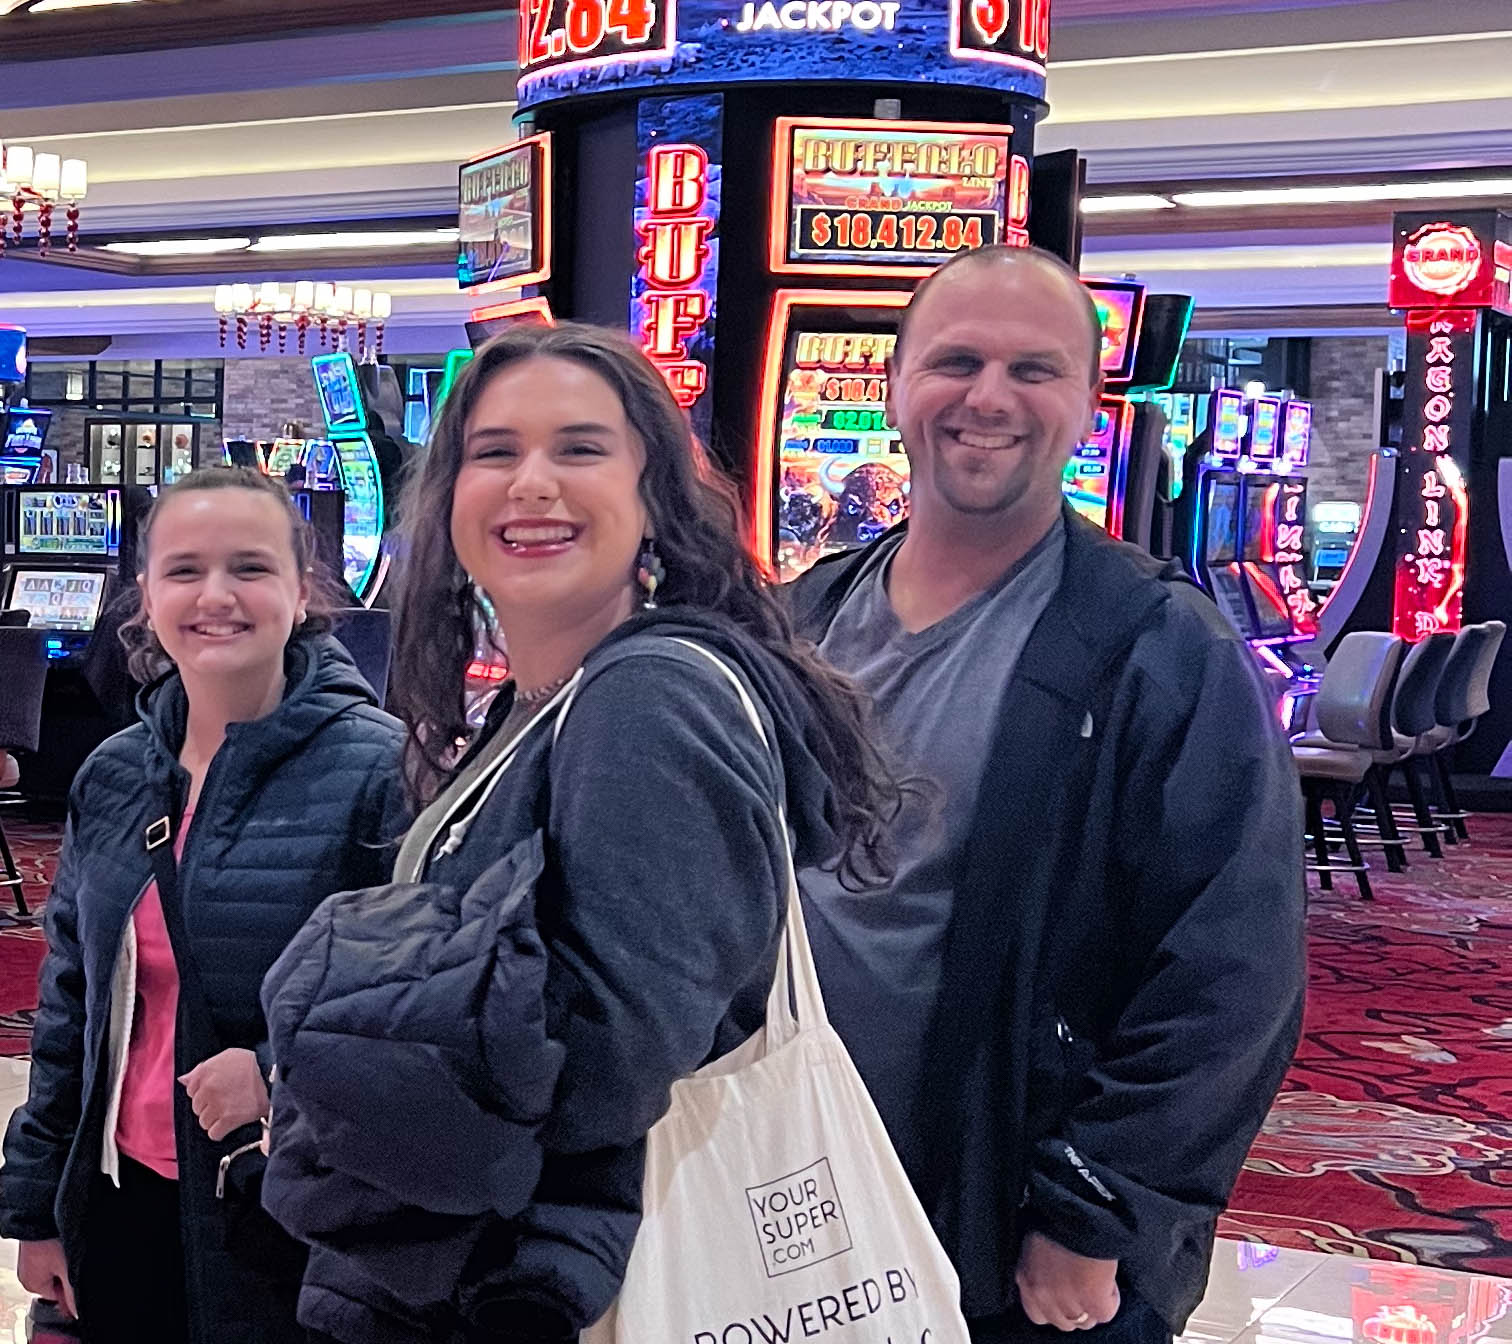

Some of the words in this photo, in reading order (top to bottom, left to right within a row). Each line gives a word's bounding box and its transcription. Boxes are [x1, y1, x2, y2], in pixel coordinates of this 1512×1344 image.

[735, 0, 902, 32] JACKPOT
[801, 138, 1001, 178] BUFFALO
[844, 196, 903, 212] GRAND
[905, 200, 953, 212] JACKPOT
[1406, 247, 1479, 262] GRAND
[753, 1179, 818, 1218] YOUR
[763, 1200, 839, 1244] SUPER
